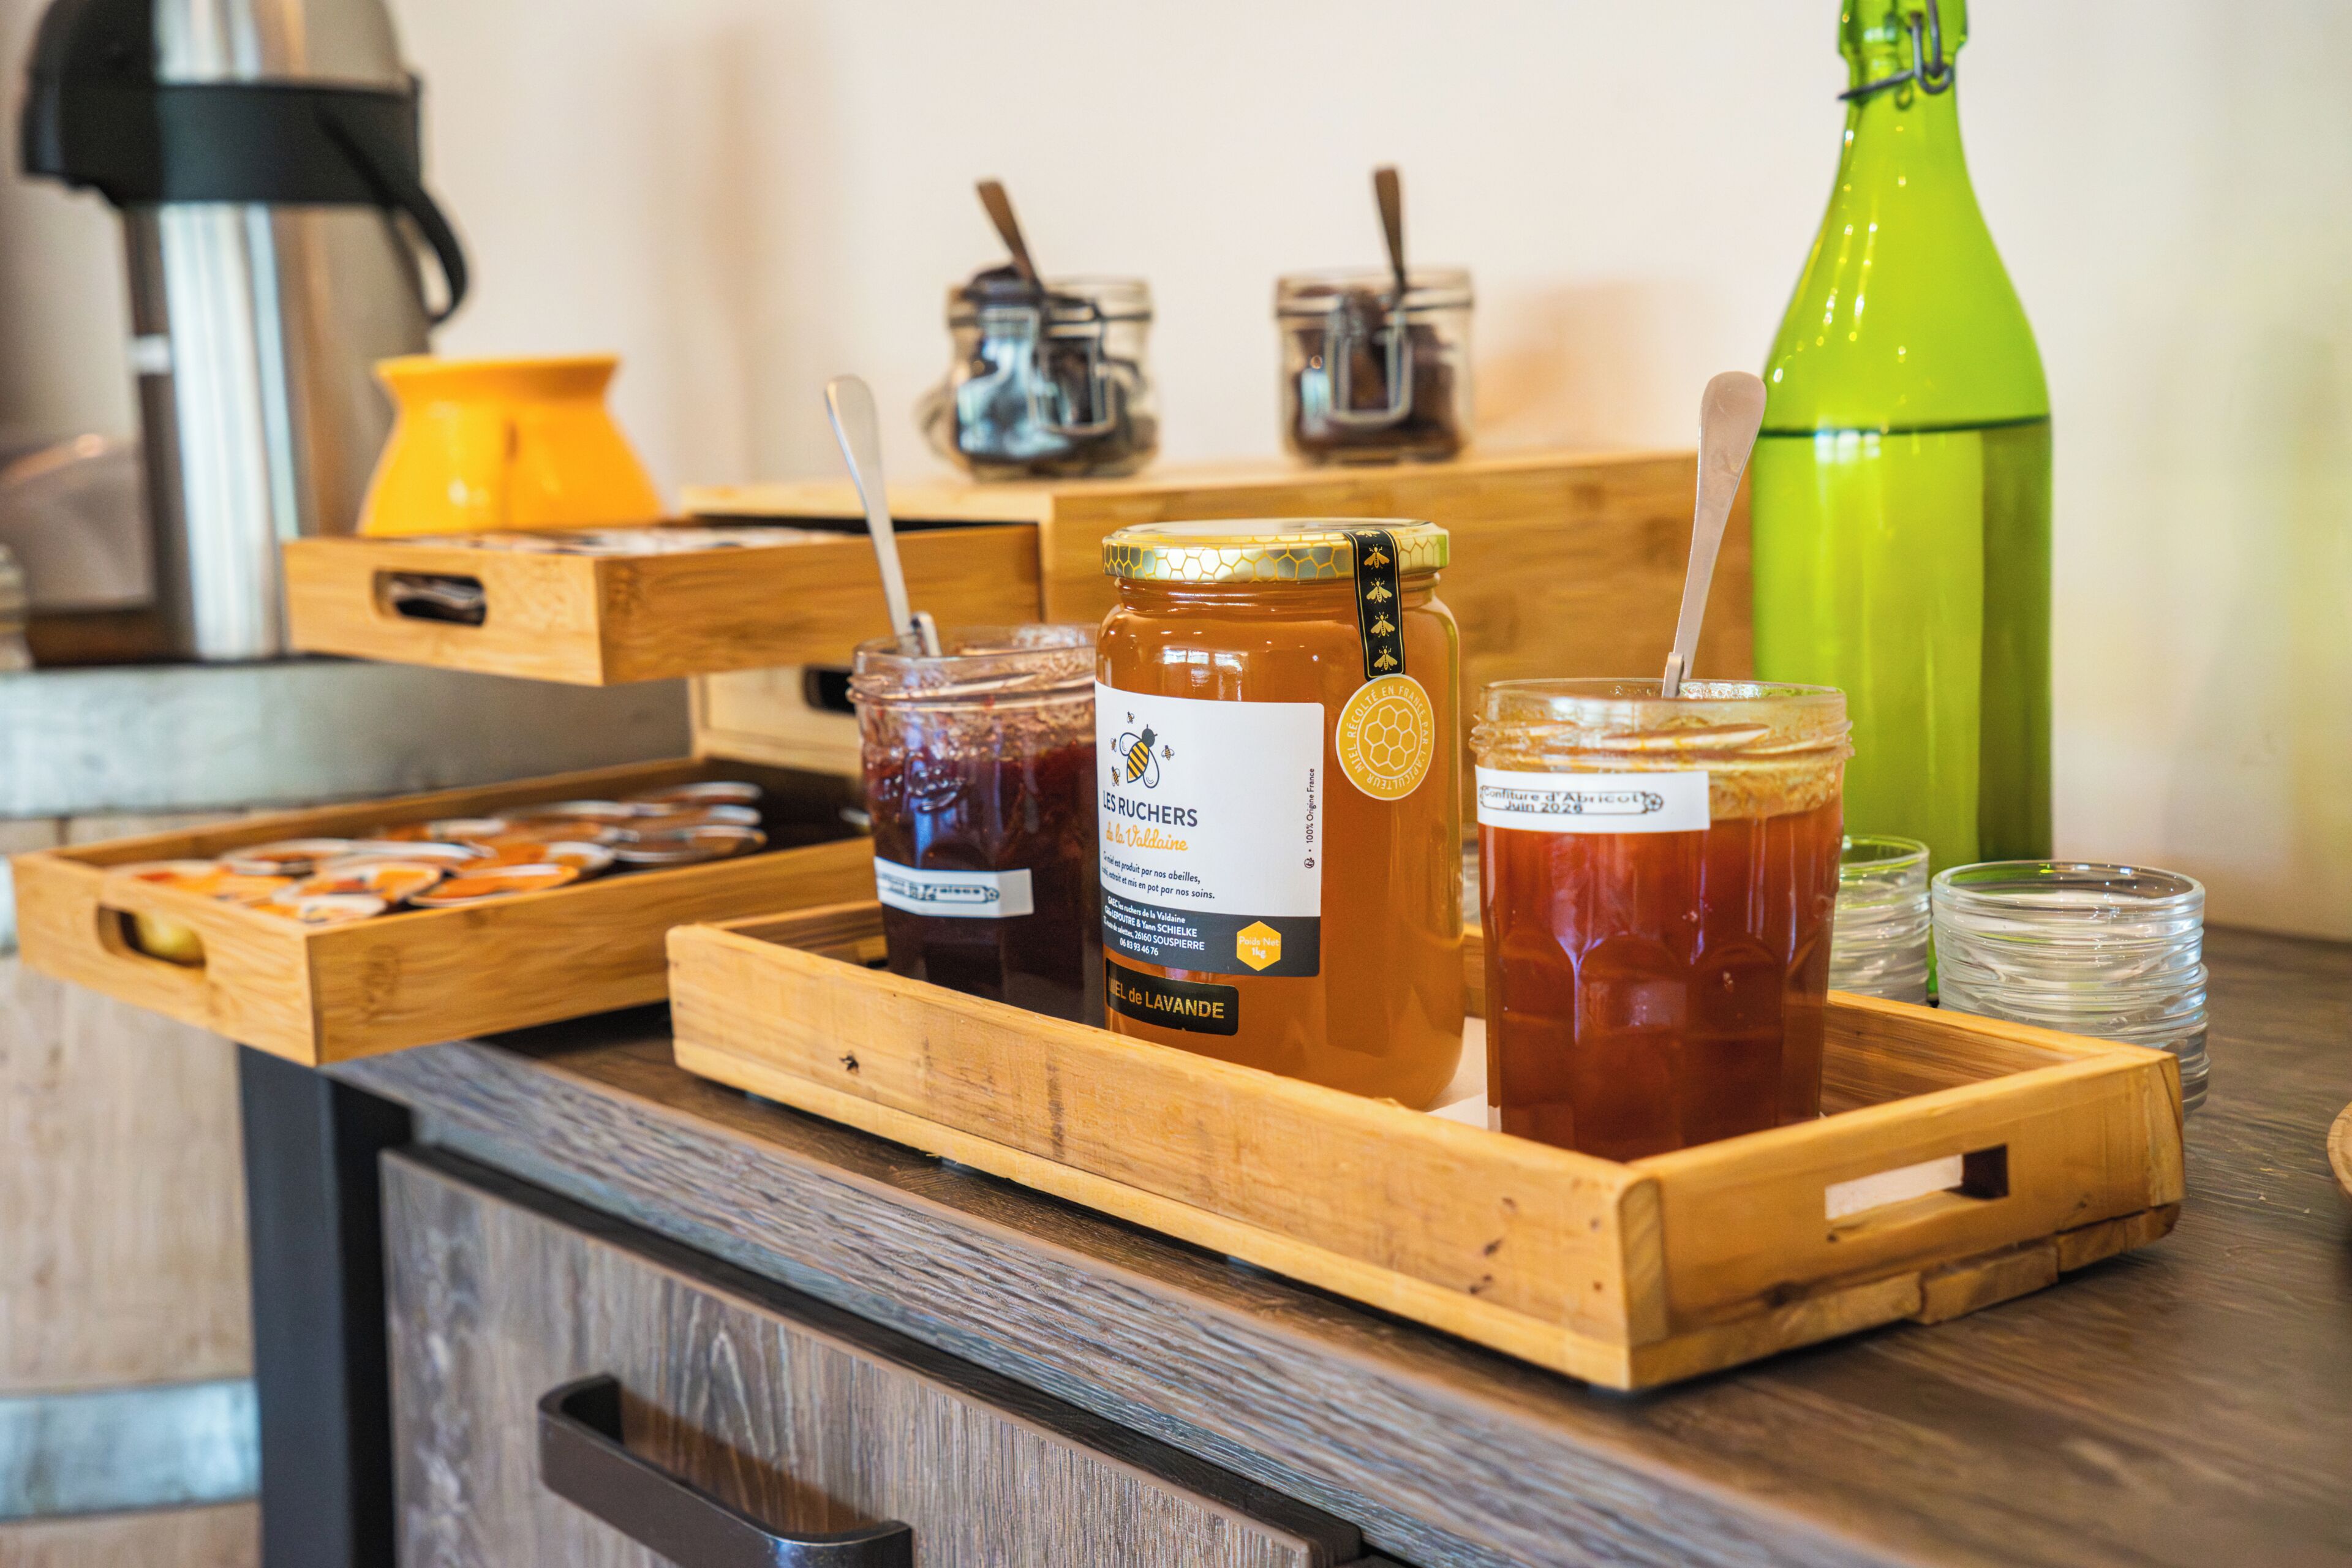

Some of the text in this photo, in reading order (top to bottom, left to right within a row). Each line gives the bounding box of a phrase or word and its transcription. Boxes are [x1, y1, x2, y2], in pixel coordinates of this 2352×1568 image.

[1381, 684, 1395, 697] EN
[1398, 685, 1426, 717] FRANCE
[1346, 688, 1379, 738] RÉCOLTÉ
[1347, 743, 1365, 774] MIEL
[1366, 750, 1427, 790] L'APICULTEUR
[1306, 767, 1315, 793] France
[1306, 794, 1317, 821] Origine
[1483, 787, 1638, 804] Confiture d'Abricot
[1504, 800, 1535, 813] Juin
[1102, 790, 1198, 827] LES RUCHERS
[1115, 823, 1125, 845] la
[1125, 824, 1189, 851] Valdaine
[1121, 862, 1140, 873] produit
[1141, 868, 1153, 878] par
[1168, 870, 1201, 885] abeilles,
[1128, 877, 1137, 888] mis
[1147, 884, 1159, 894] pot
[1160, 886, 1174, 896] par
[1191, 888, 1215, 899] soins.
[1111, 909, 1136, 927] LEPOUTRE
[1136, 919, 1142, 928] &
[1141, 920, 1156, 932] Yann
[1157, 923, 1198, 938] SCHIELKE
[1124, 905, 1142, 916] ruchers
[1142, 908, 1150, 918] de
[1150, 910, 1156, 919] la
[1156, 911, 1186, 924] Valdaine
[1120, 937, 1159, 956] 06 83 93 46 76
[1134, 930, 1152, 943] 26160
[1152, 934, 1205, 951] SOUSPIERRE
[1238, 936, 1280, 946] Poids Net
[1251, 946, 1266, 959] 1kg
[1128, 987, 1143, 1006] de
[1145, 990, 1225, 1019] LAVANDE
